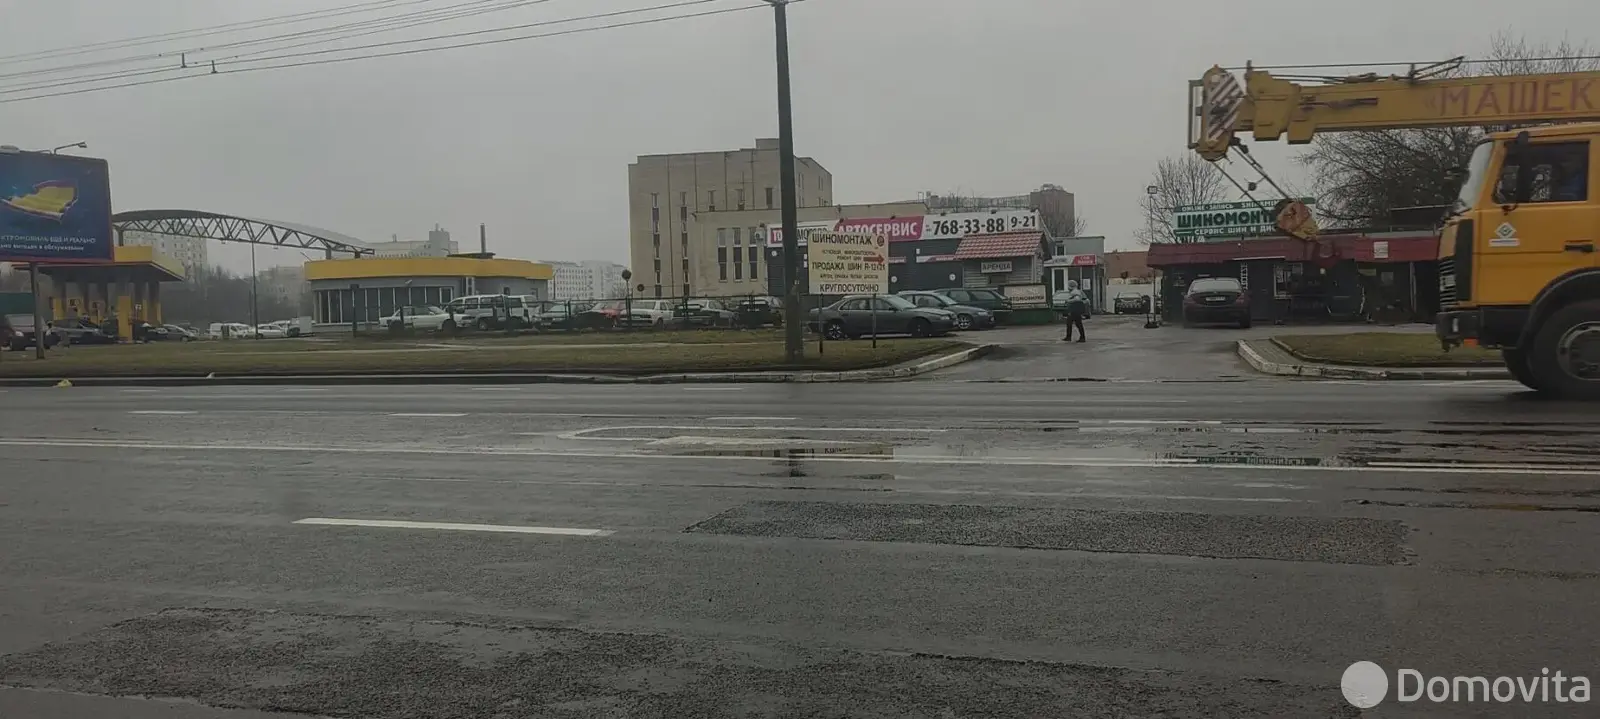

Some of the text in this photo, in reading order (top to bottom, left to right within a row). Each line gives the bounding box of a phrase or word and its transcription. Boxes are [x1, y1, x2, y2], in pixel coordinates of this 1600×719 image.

[1177, 210, 1276, 228] ШИНОМОНТ
[838, 222, 918, 237] АВТОСЕРВИС
[933, 217, 1004, 236] 768-33-88
[1011, 215, 1036, 228] 9-21
[1228, 226, 1247, 234] ШИН
[812, 233, 872, 245] ШИНОМОНТАЖ
[812, 262, 844, 270] ПРОДАЖА
[848, 262, 862, 270] ШИН
[982, 263, 1010, 271] АРЕНДА
[820, 284, 879, 292] КРУГЛОСУТОЧНО
